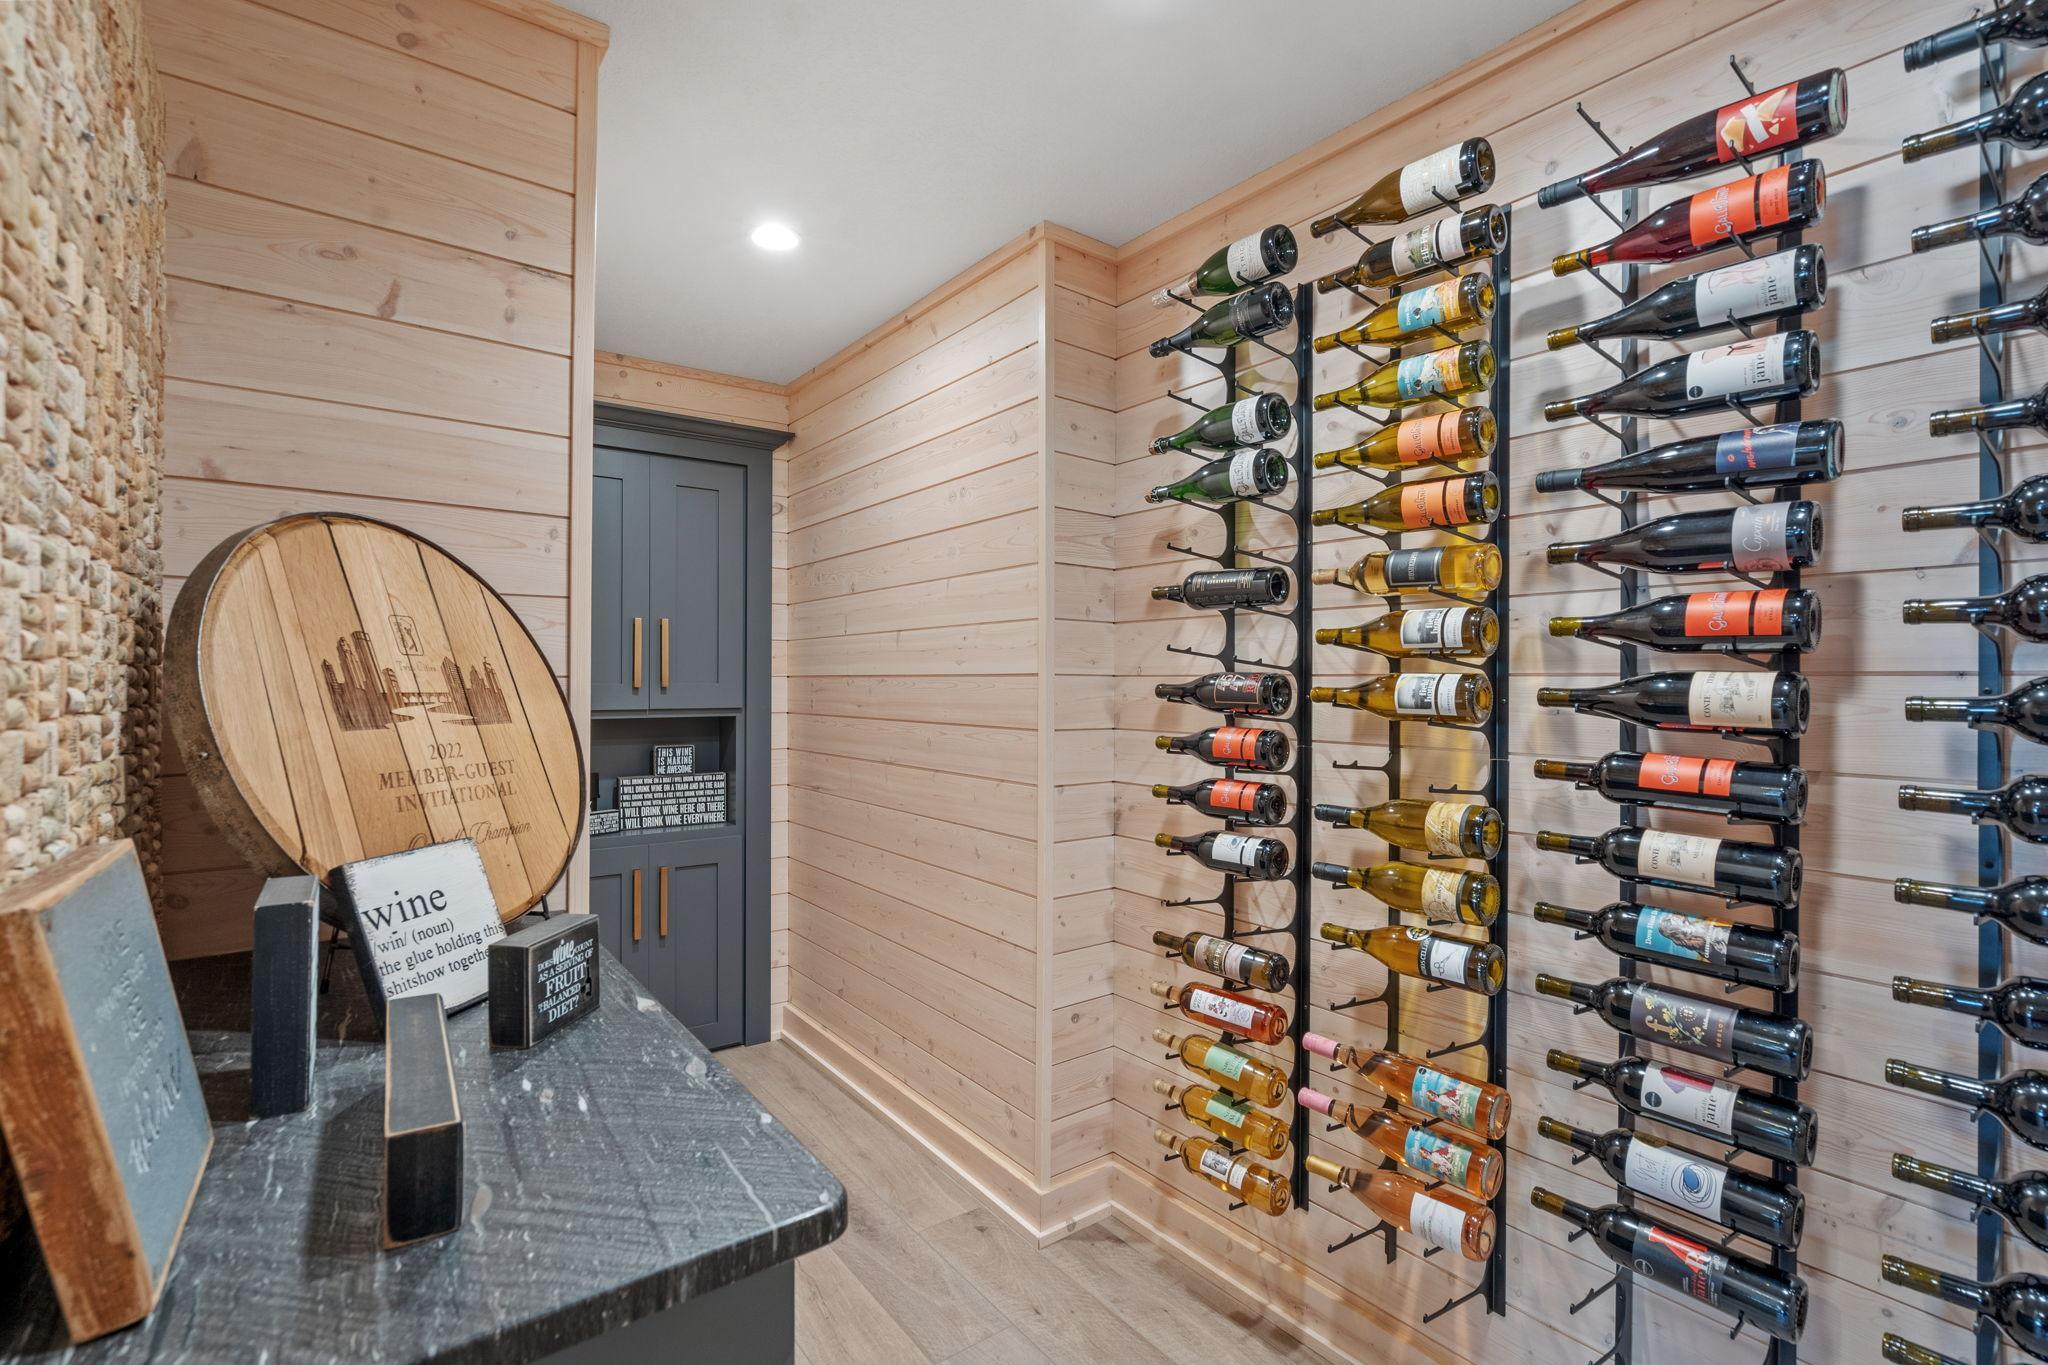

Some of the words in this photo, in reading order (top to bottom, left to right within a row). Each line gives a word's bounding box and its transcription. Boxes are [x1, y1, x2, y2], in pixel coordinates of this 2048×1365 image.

[1765, 275, 1785, 308] jane
[1753, 352, 1772, 384] jane
[428, 742, 464, 761] 2022
[658, 748, 673, 757] THIS
[675, 747, 692, 756] WINE
[658, 757, 665, 765] IS
[667, 755, 692, 765] MAKING
[378, 760, 516, 791] MEMBER-GUEST
[658, 766, 665, 774] ME
[667, 765, 692, 774] AWESOME
[396, 781, 518, 813] INVITATIONAL
[625, 807, 639, 817] WILL
[641, 806, 661, 816] DRINK
[662, 804, 679, 815] WINE
[680, 803, 695, 814] HERE
[707, 802, 725, 811] THERE
[470, 821, 531, 845] Champion
[625, 817, 641, 829] WILL
[643, 816, 663, 827] DRINK
[665, 814, 682, 826] WINE
[683, 812, 725, 824] EVERYWHERE
[361, 889, 448, 931] wine
[411, 917, 454, 944] (noun)
[379, 957, 402, 976] the
[405, 949, 434, 971] glue
[435, 931, 482, 956] holding
[483, 919, 505, 938] this
[552, 939, 575, 965] wine
[574, 938, 594, 954] COUNT
[387, 965, 445, 998] shitshow
[448, 947, 489, 971] togethe
[537, 971, 548, 984] AS
[549, 967, 555, 978] A
[556, 952, 584, 974] SERVING
[585, 947, 594, 959] OF
[545, 962, 587, 998] FRUIT
[543, 983, 581, 1011] BALANCED
[548, 994, 579, 1023] DIET?
[1702, 1095, 1721, 1130] jane
